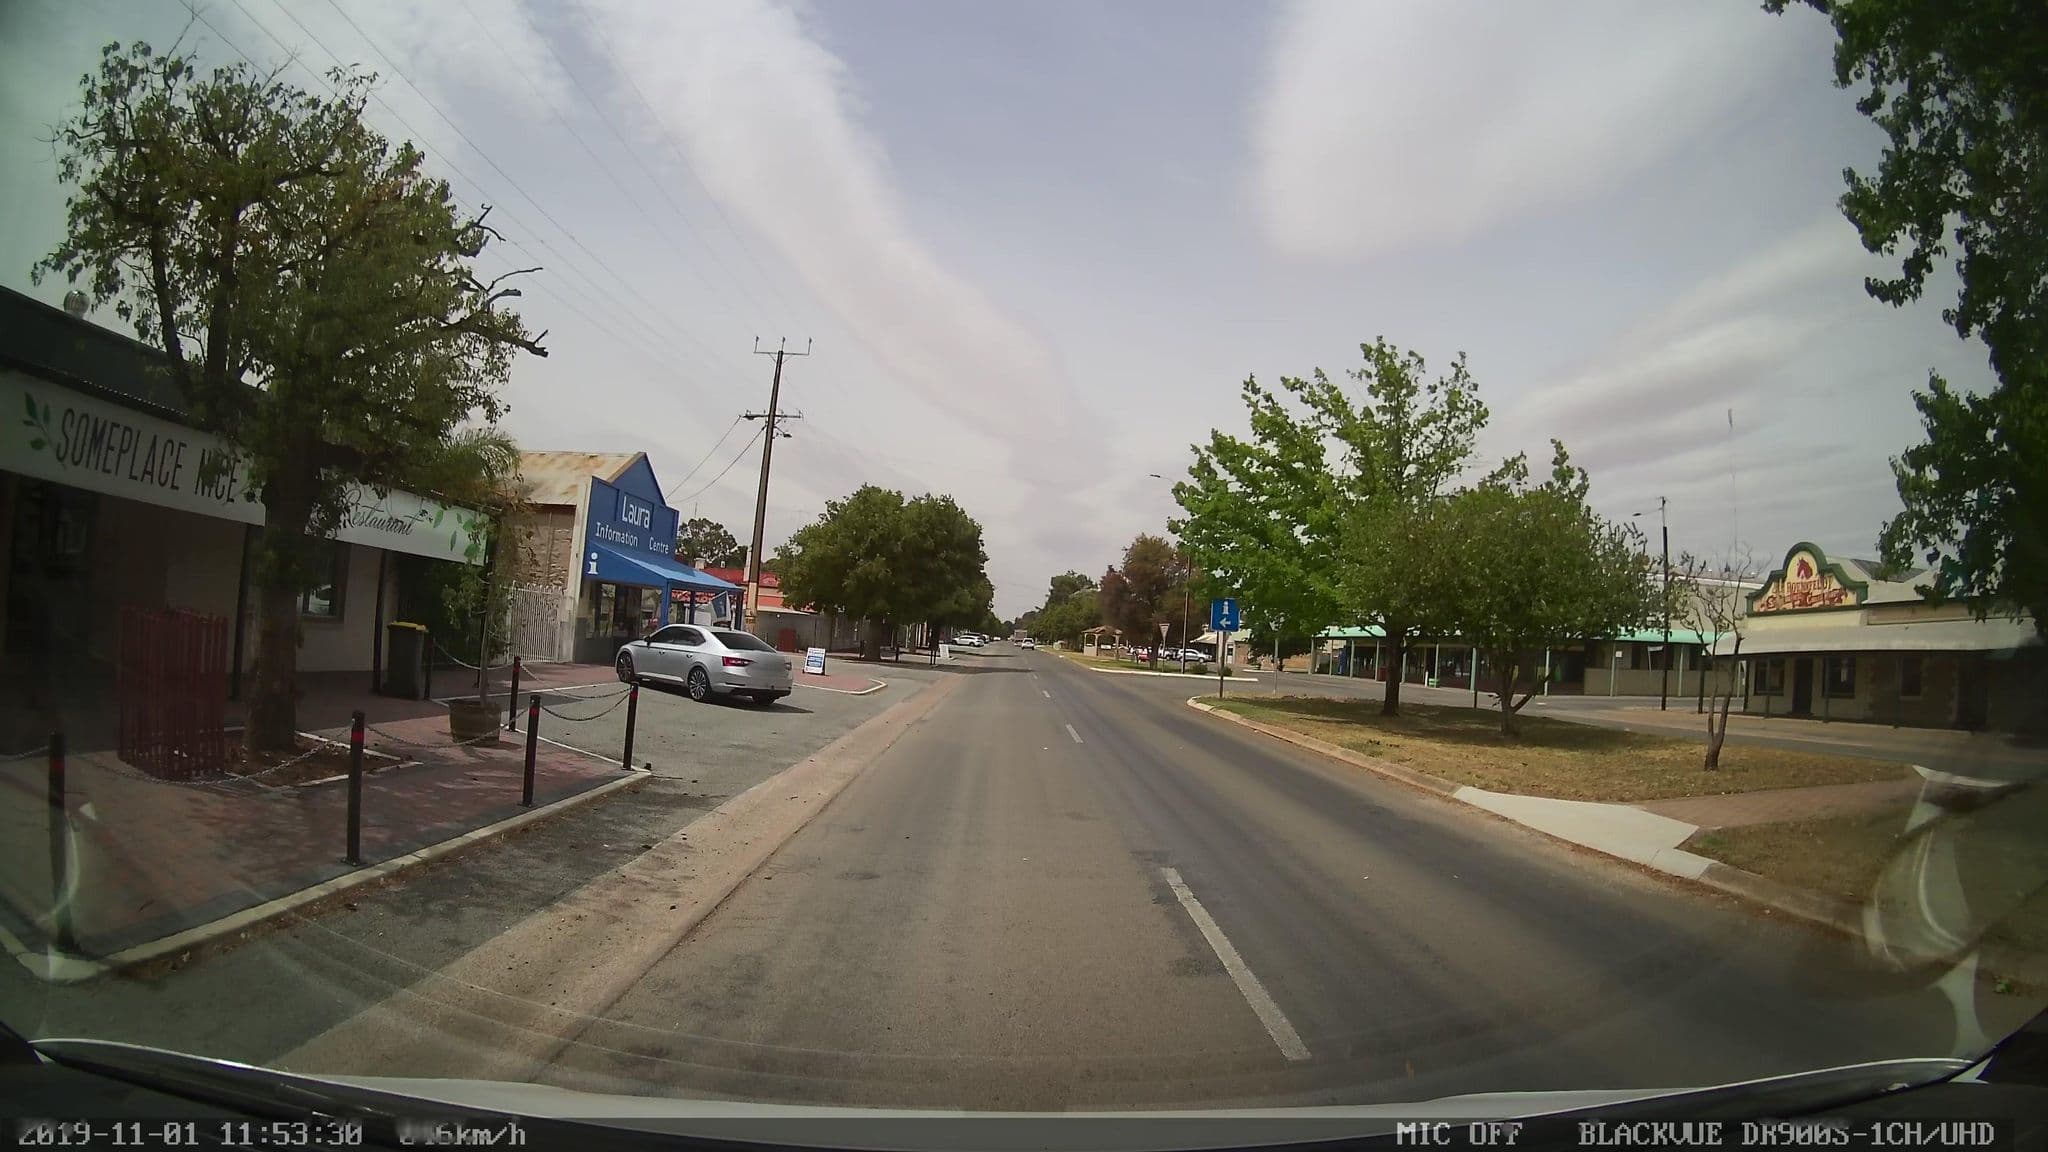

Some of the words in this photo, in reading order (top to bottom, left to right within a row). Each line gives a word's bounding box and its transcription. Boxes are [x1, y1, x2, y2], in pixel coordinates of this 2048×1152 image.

[55, 407, 188, 491] SOMEPLACE
[194, 447, 242, 503] NCE
[621, 495, 651, 529] Laura
[595, 521, 639, 547] Information
[648, 536, 669, 554] Centre
